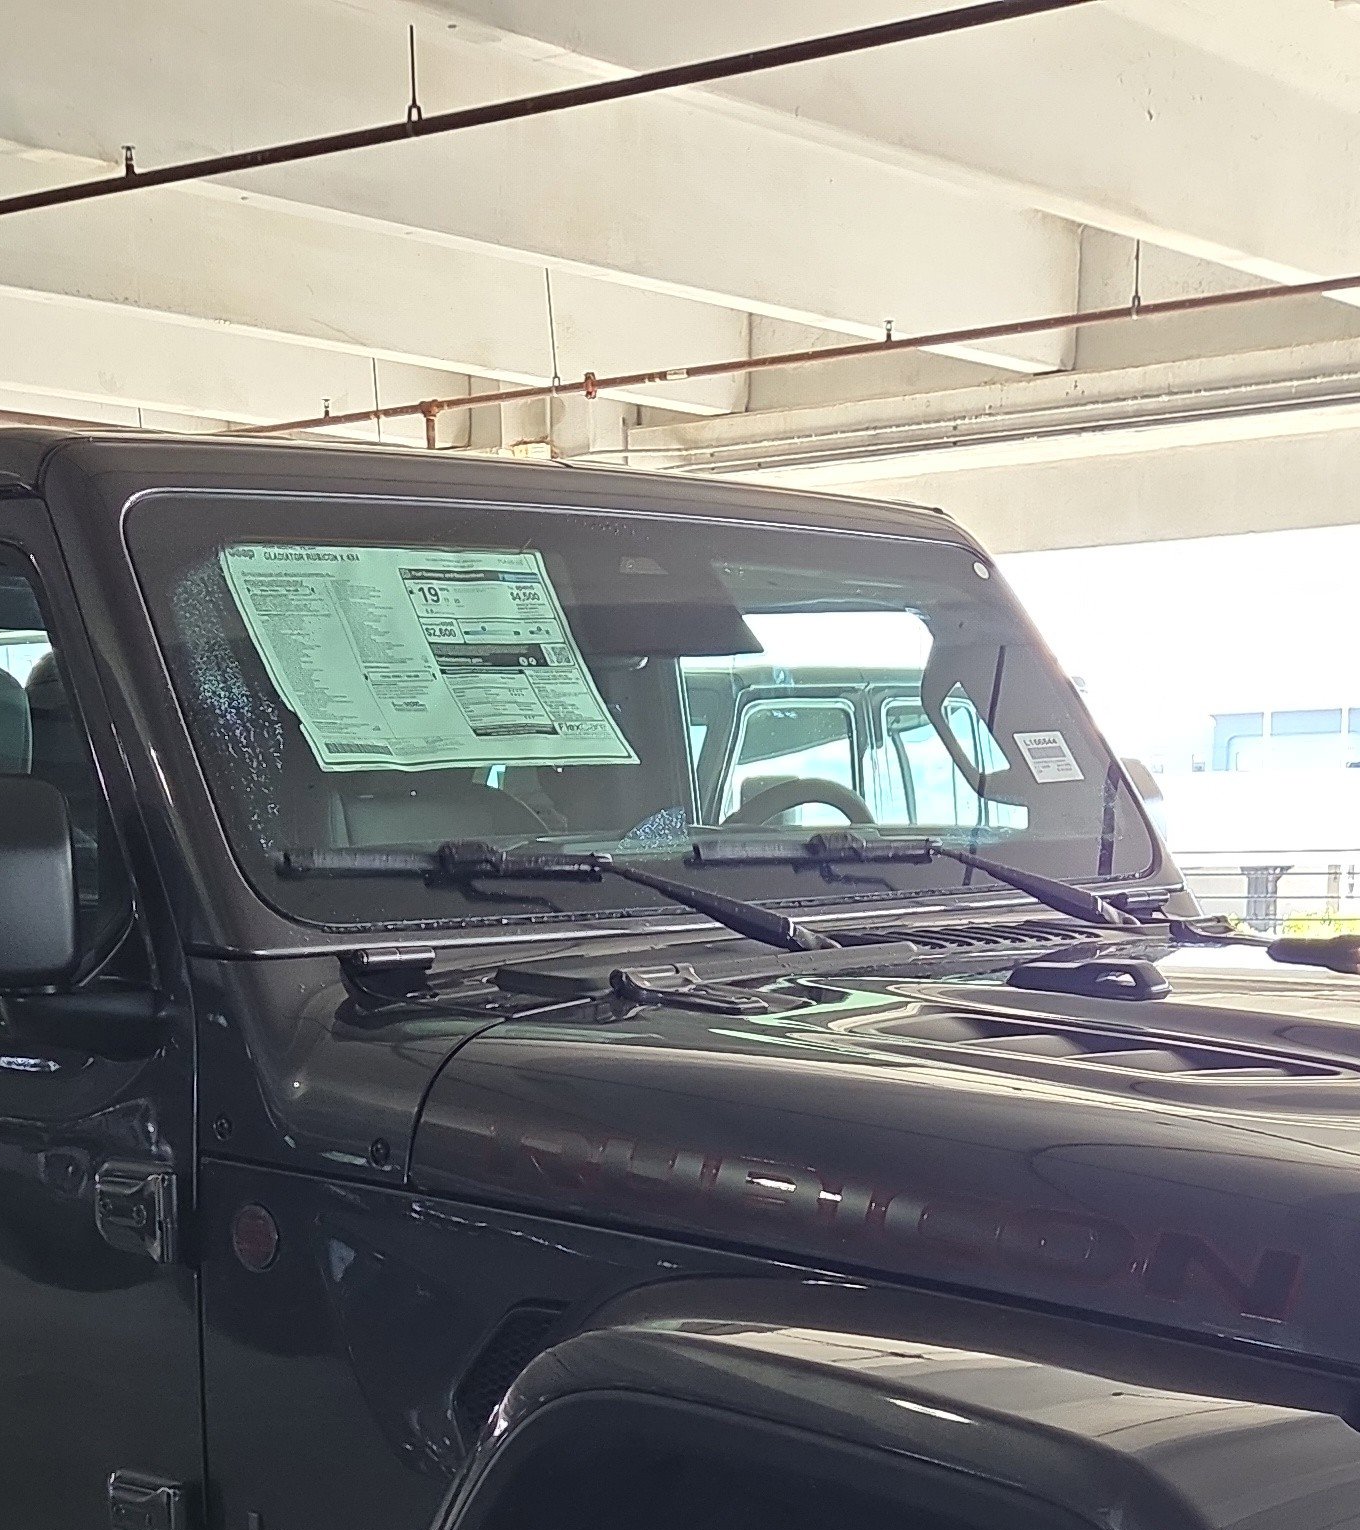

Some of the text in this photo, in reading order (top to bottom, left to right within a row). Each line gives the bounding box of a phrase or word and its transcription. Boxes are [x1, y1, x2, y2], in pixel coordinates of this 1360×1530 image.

[264, 551, 304, 562] GLADIATOR
[306, 552, 339, 562] RUBICON
[418, 586, 440, 604] 19
[485, 1122, 1304, 1327] RUBICON
